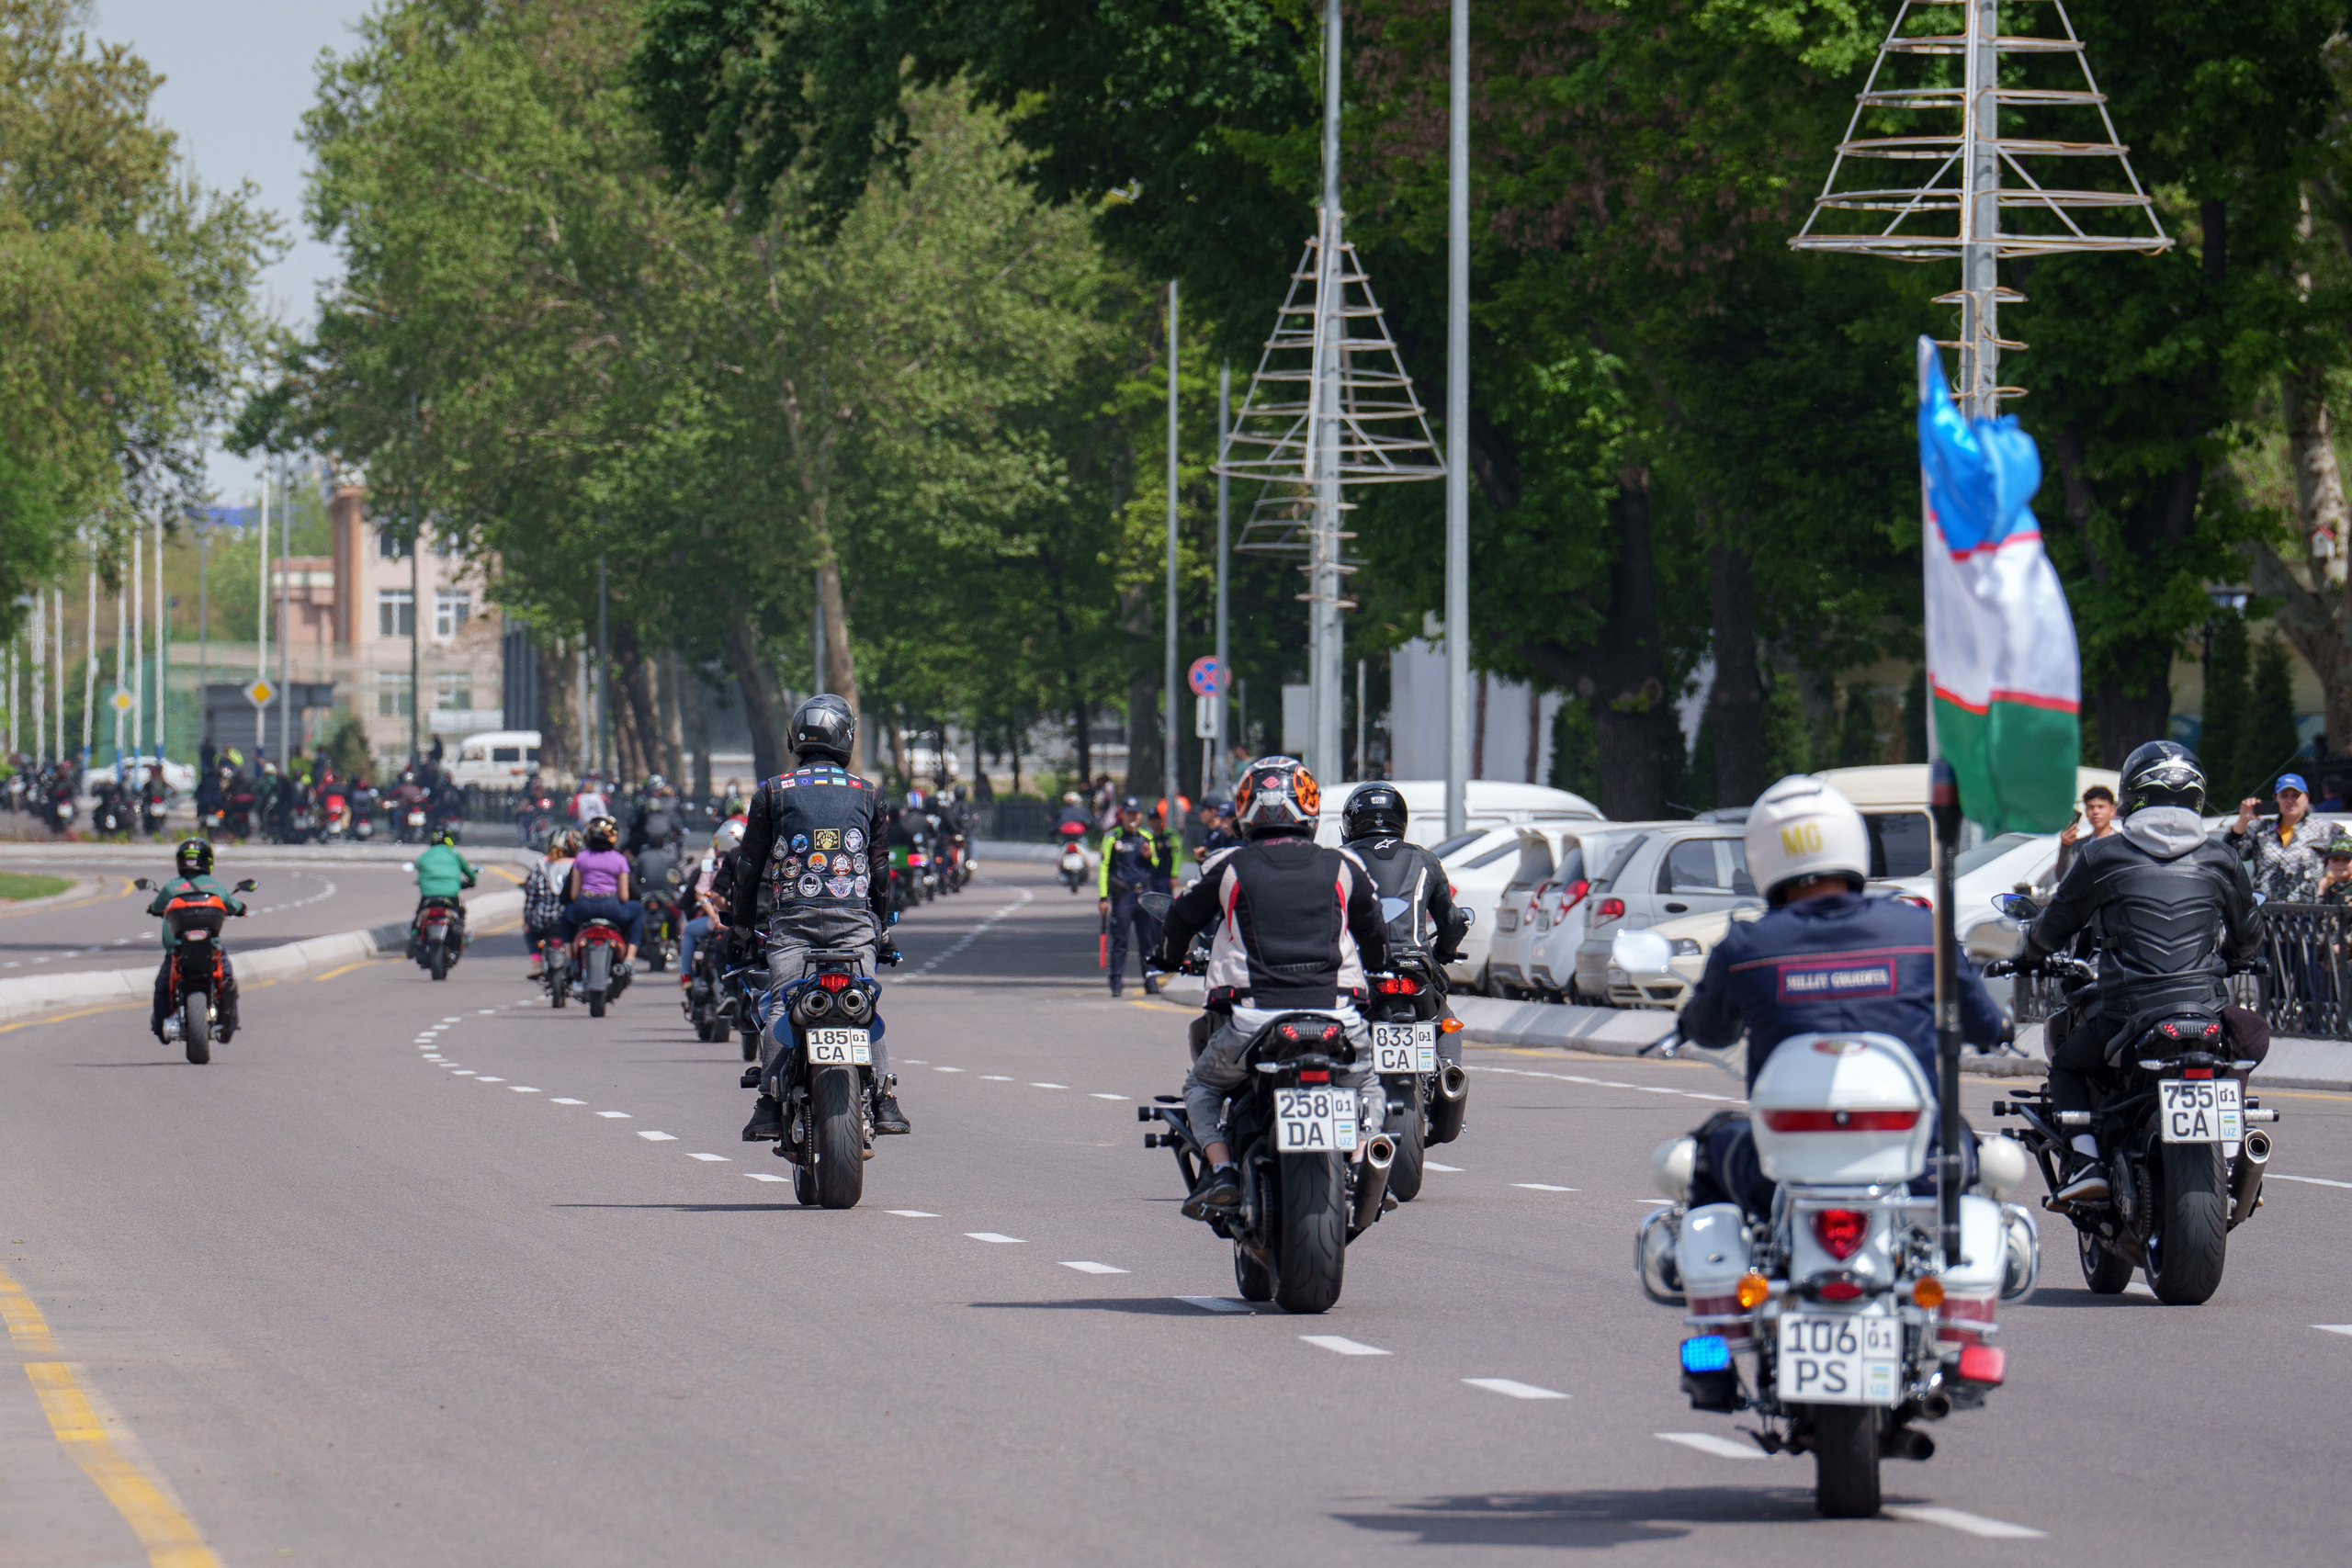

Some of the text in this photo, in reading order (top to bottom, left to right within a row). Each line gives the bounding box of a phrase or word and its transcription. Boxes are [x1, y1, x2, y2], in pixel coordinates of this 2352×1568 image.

[1780, 823, 1823, 858] MG
[811, 1030, 848, 1044] 185
[1376, 1027, 1431, 1046] 833 01
[817, 1046, 844, 1060] CA
[1382, 1049, 1409, 1068] CA
[1280, 1094, 1351, 1118] 258 01
[2164, 1085, 2236, 1109] 755 01
[1287, 1122, 1352, 1145] DA UZ
[2172, 1110, 2236, 1137] CA UZ
[1785, 1320, 1892, 1354] 106 01
[1795, 1359, 1889, 1395] PS UZ
